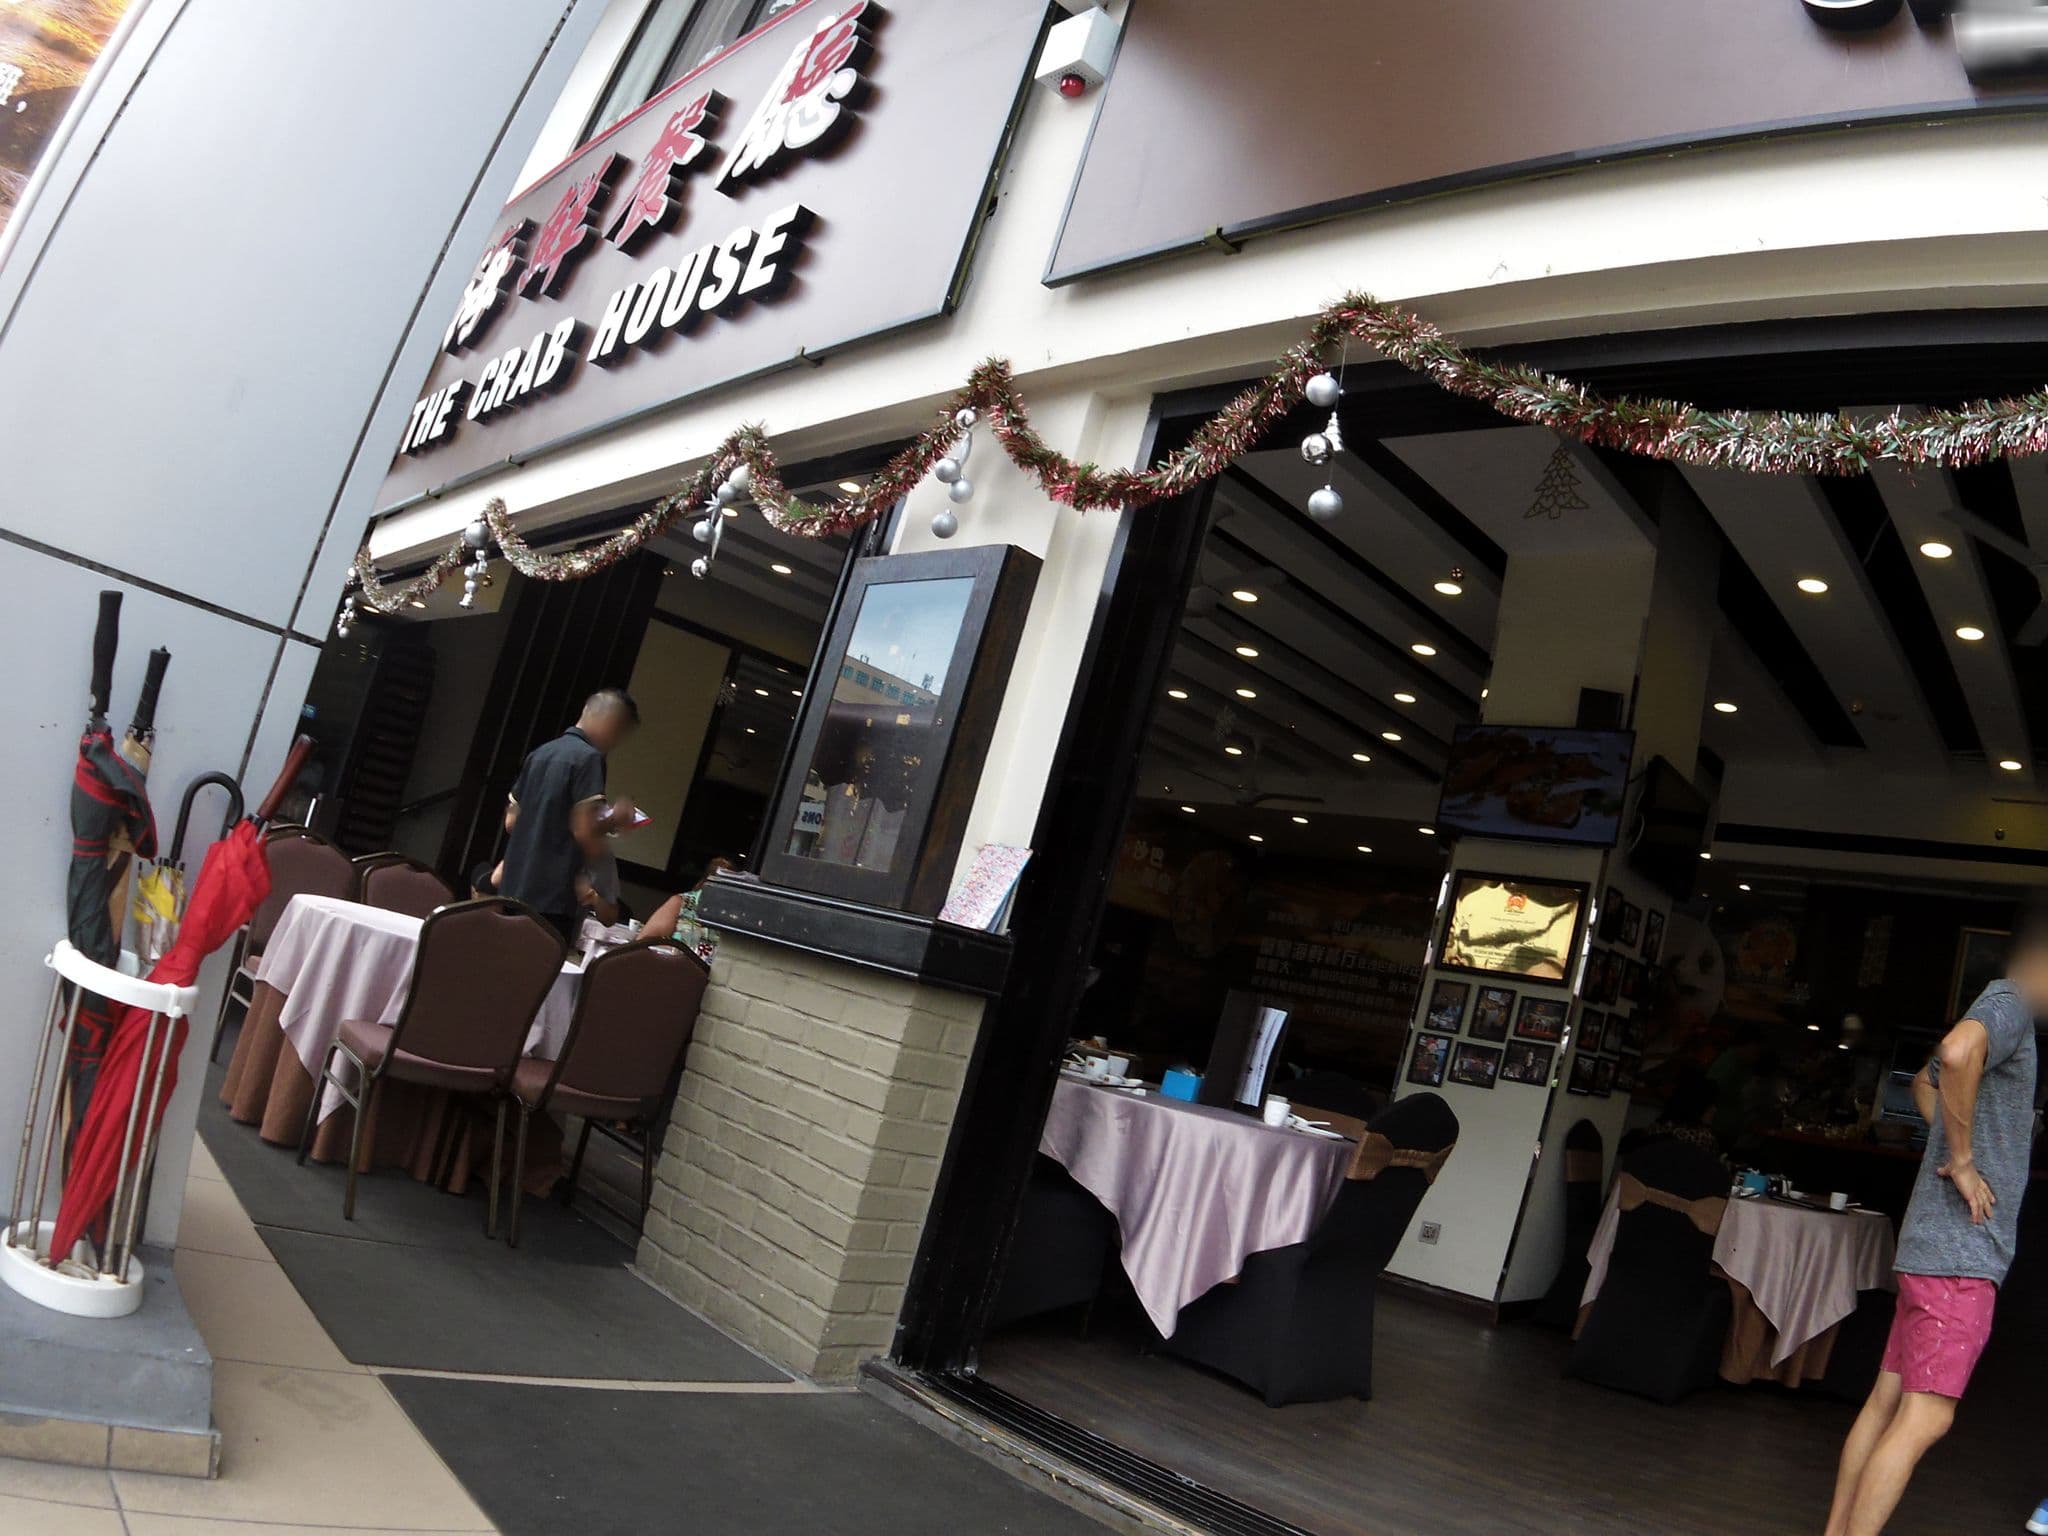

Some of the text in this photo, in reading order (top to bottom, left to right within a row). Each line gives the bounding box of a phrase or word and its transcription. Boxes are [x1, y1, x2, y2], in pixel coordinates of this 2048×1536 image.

[400, 203, 800, 453] THE CRAB HOUSE
